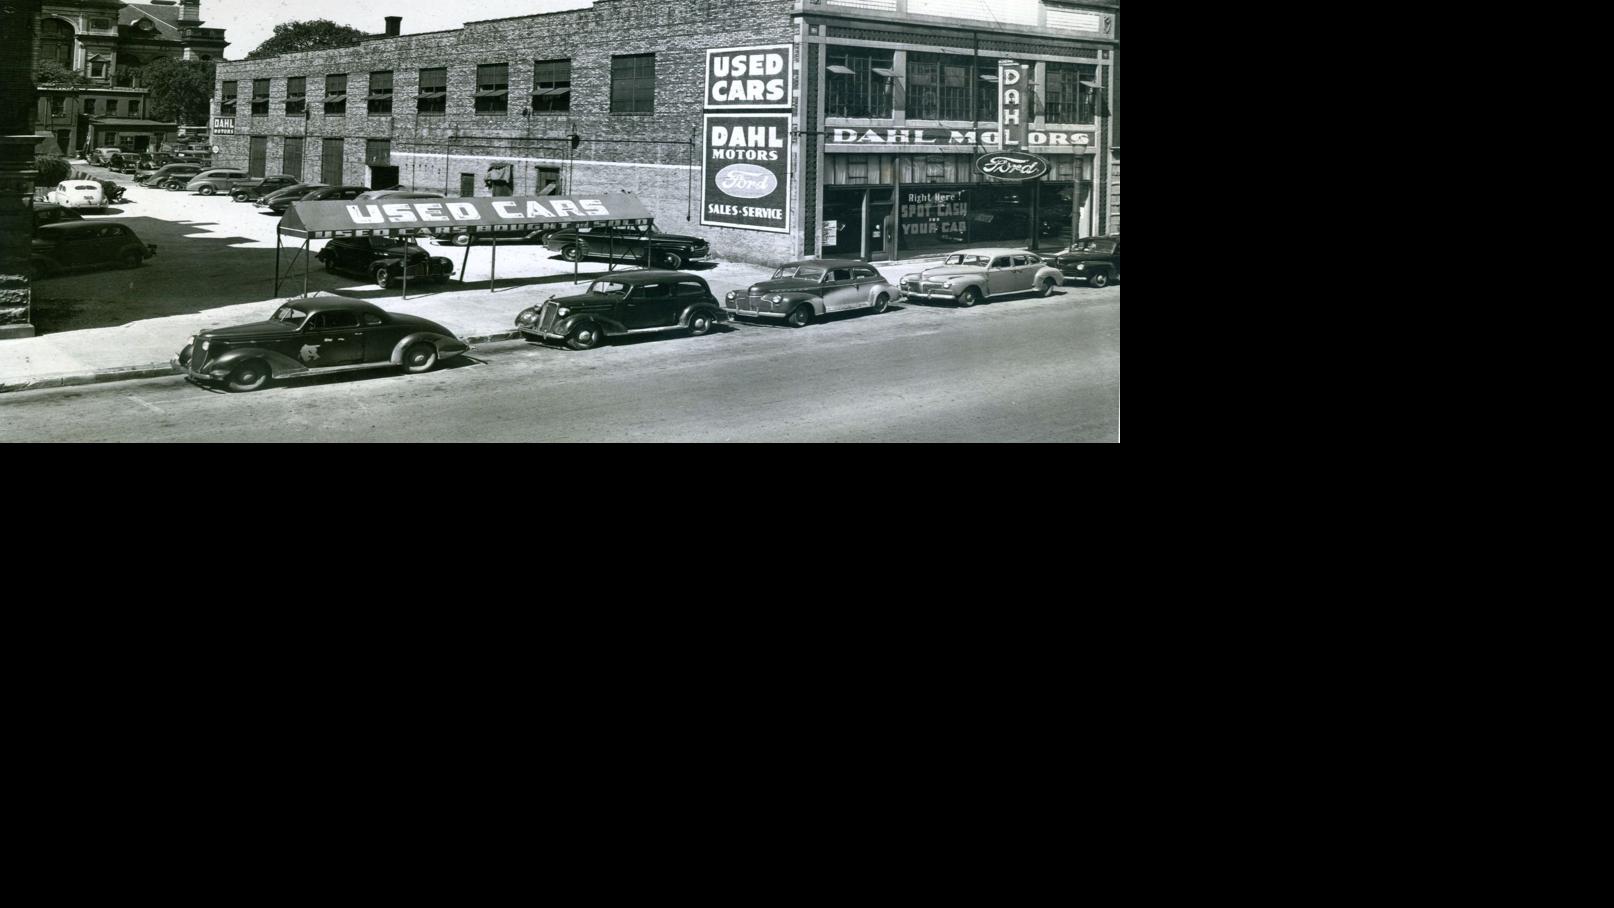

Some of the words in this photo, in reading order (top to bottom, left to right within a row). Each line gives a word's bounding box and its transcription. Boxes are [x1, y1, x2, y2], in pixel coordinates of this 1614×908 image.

[713, 53, 784, 77] USED
[711, 78, 785, 102] CARS
[1003, 69, 1020, 145] DAHL
[214, 118, 234, 128] DAHL
[711, 126, 784, 148] DAHL
[833, 128, 938, 145] DAHL
[948, 130, 1090, 145] MOORS
[712, 149, 779, 161] MOTORS
[982, 156, 1040, 174] Ford
[721, 169, 770, 190] Ford
[908, 193, 931, 203] Right
[346, 203, 481, 224] USED
[490, 199, 610, 219] CARS
[901, 204, 931, 218] SPOT
[937, 202, 967, 216] CASH
[315, 229, 390, 238] USED
[398, 226, 467, 235] CARS
[476, 222, 568, 232] BOUGHT
[902, 223, 938, 235] YOUR
